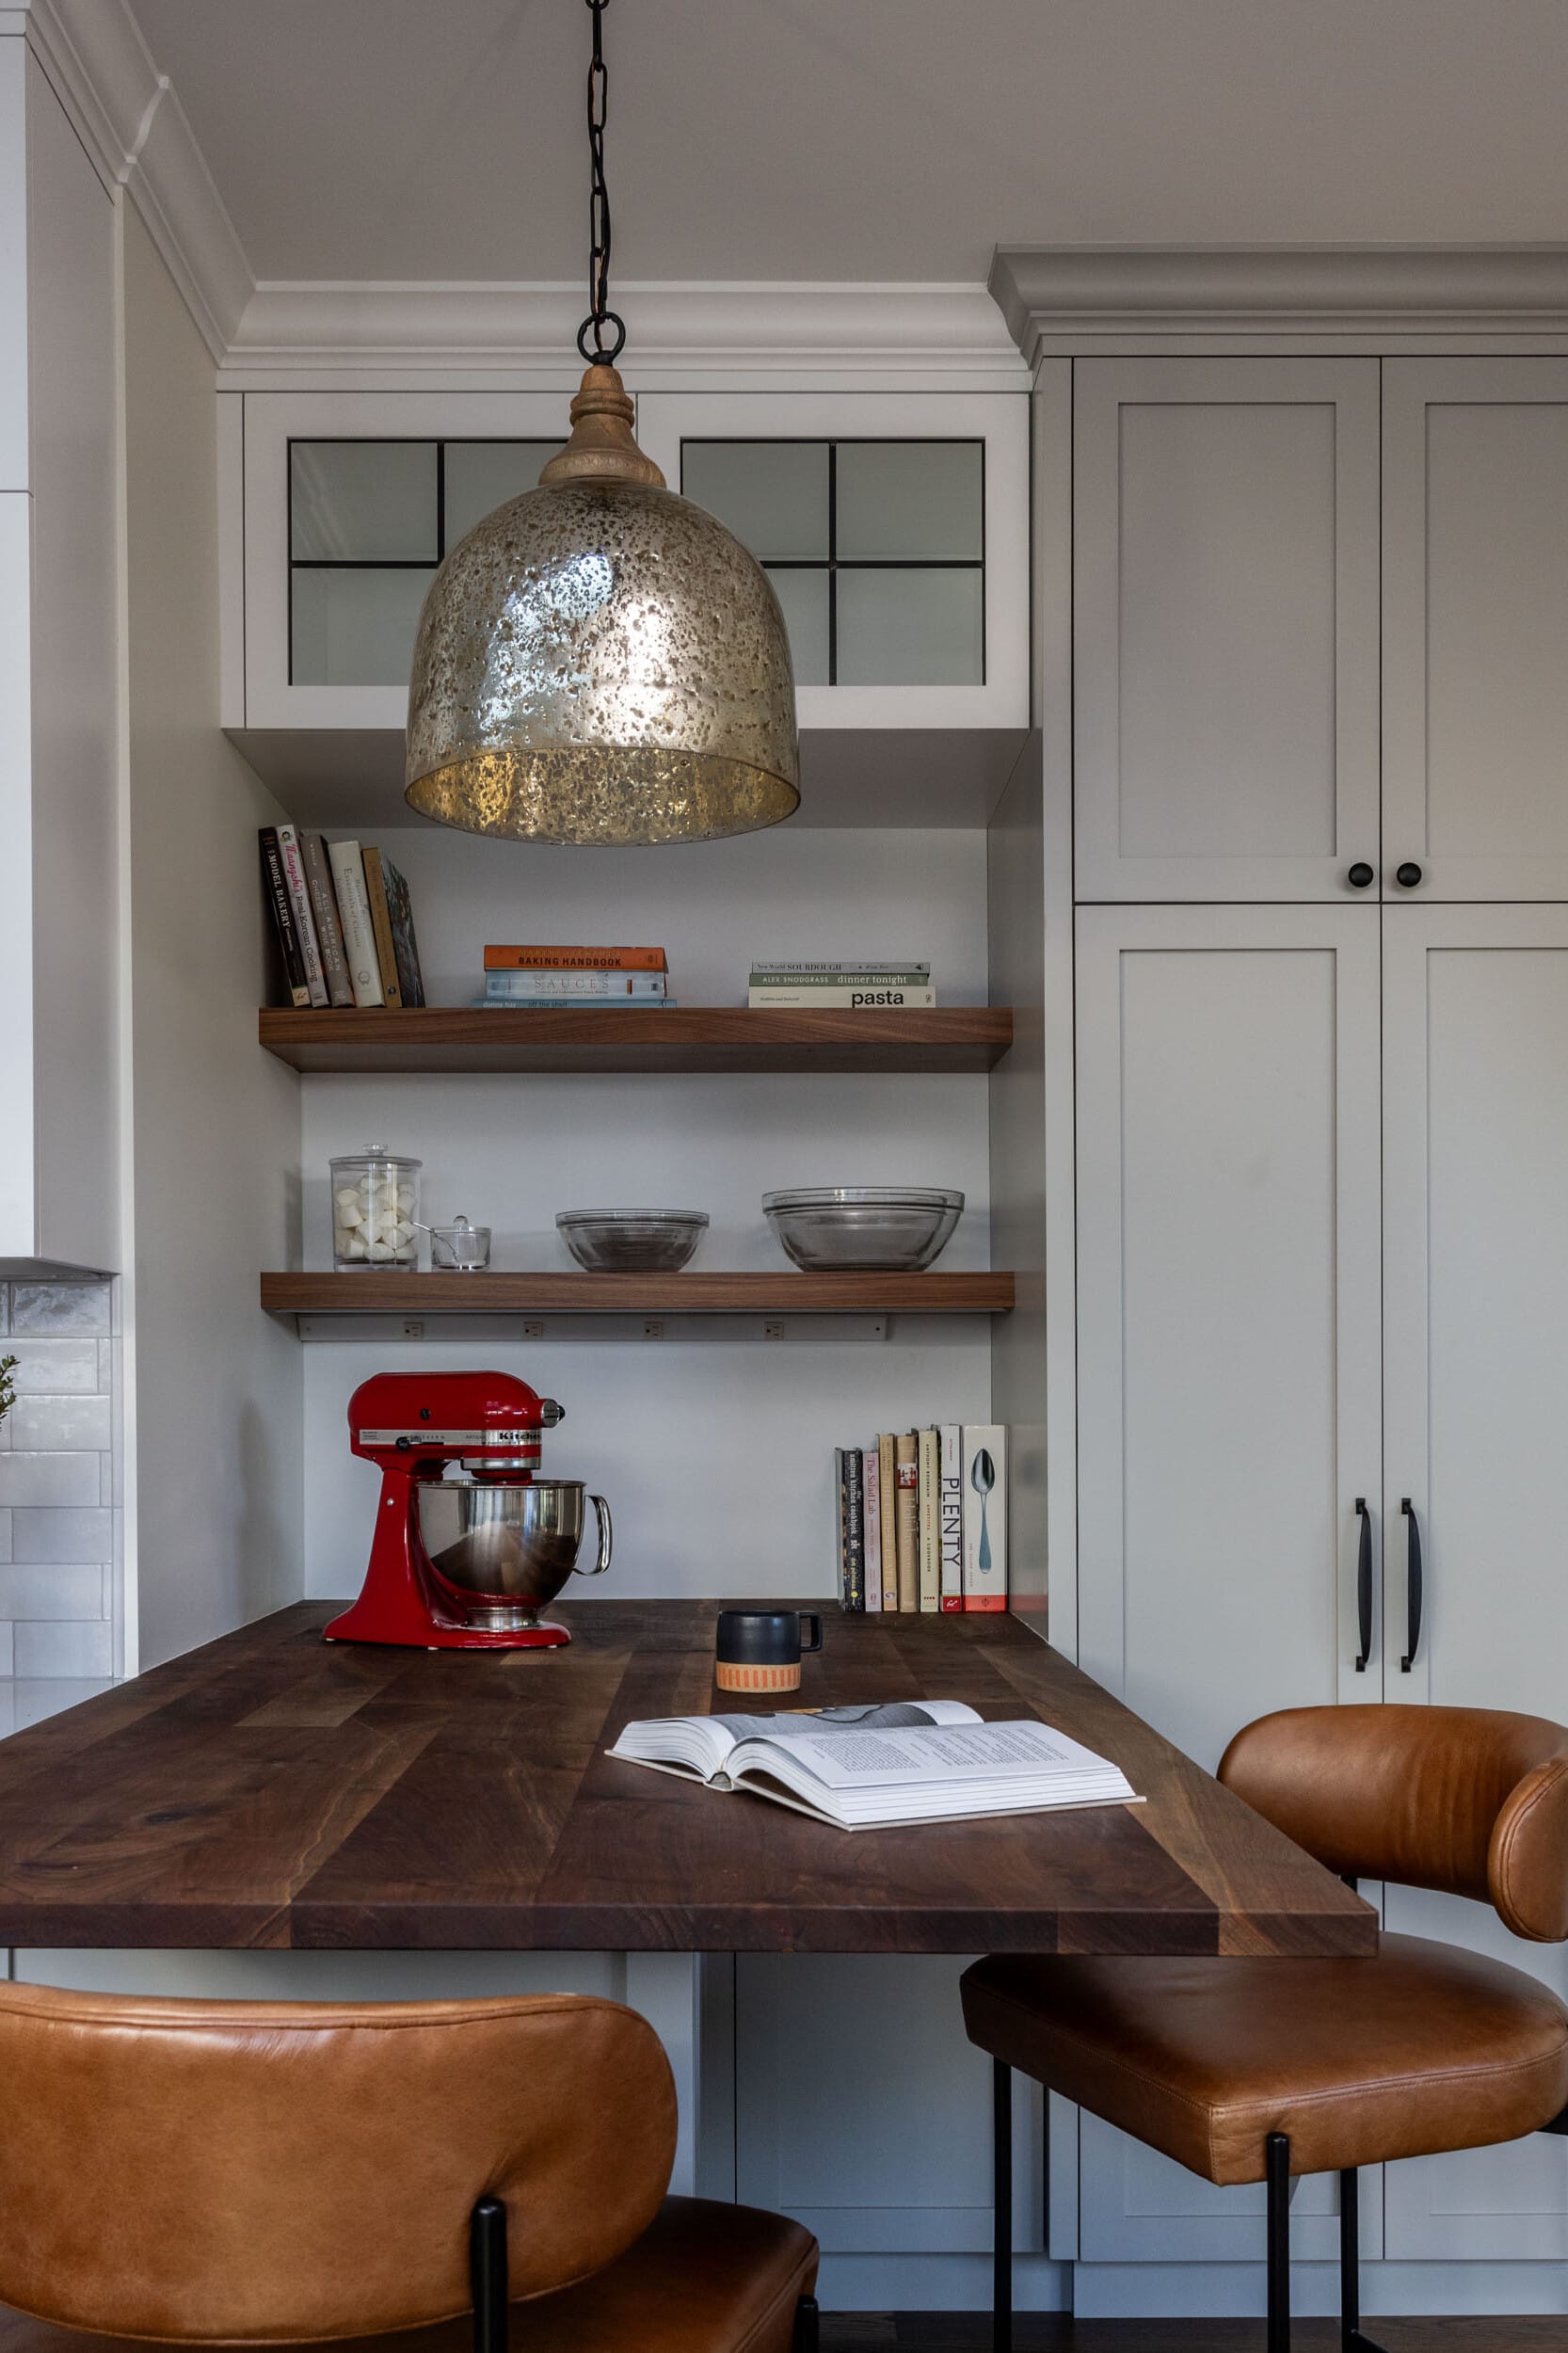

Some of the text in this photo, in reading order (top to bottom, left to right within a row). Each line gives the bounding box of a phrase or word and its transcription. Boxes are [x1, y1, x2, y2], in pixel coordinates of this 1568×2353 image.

[269, 855, 282, 887] MODEL
[276, 889, 290, 927] BAKERY
[295, 895, 305, 913] Real
[299, 915, 311, 945] Korean
[321, 925, 329, 945] WINE
[325, 949, 334, 971] BOOK
[326, 916, 340, 971] AMERICAN
[306, 947, 318, 982] Cooking
[563, 957, 621, 966] HANDBOOK
[535, 978, 609, 988] SAUCES
[873, 975, 907, 985] tonight
[852, 990, 904, 1008] pasta
[866, 1459, 875, 1473] The
[849, 1479, 858, 1503] kitchen
[867, 1475, 875, 1497] Salad
[867, 1499, 876, 1514] Lab
[902, 1498, 916, 1545] Holiday
[942, 1477, 960, 1566] PLENTY
